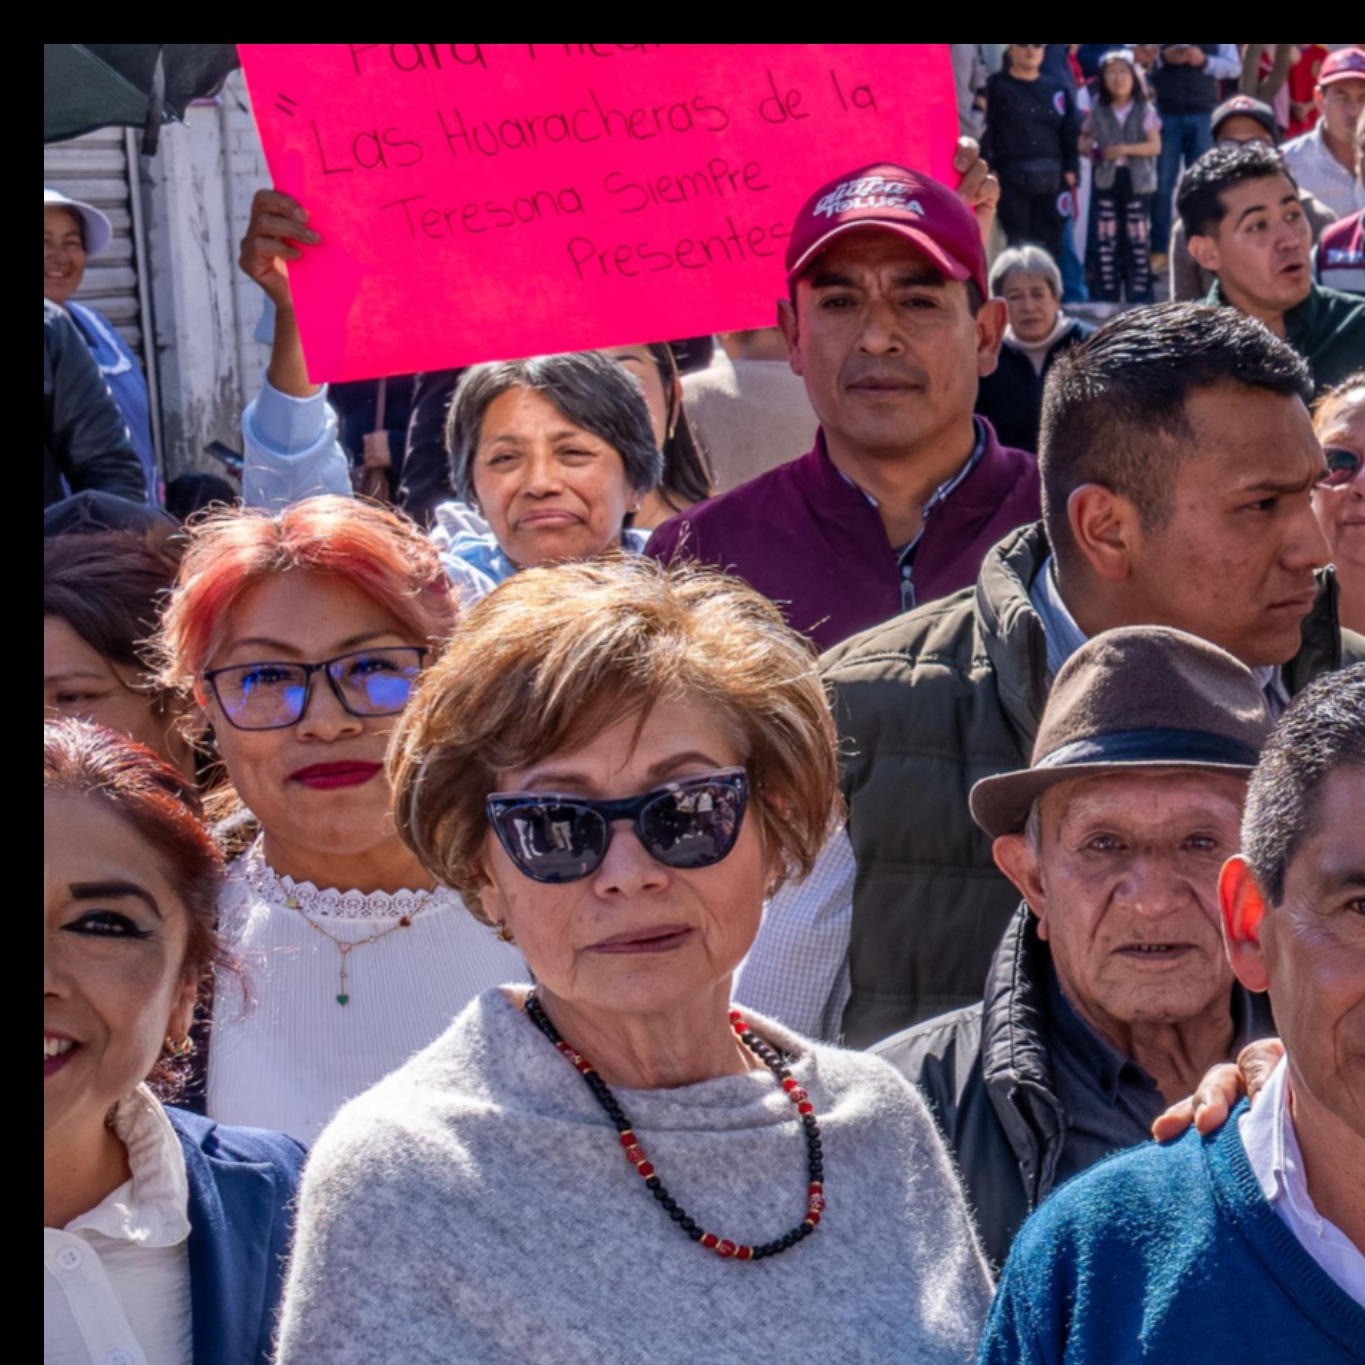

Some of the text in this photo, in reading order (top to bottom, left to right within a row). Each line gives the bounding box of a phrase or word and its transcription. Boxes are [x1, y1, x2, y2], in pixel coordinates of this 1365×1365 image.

[436, 88, 730, 158] Huaracheras
[758, 69, 811, 125] de
[829, 69, 879, 116] la
[380, 186, 586, 240] Teresona
